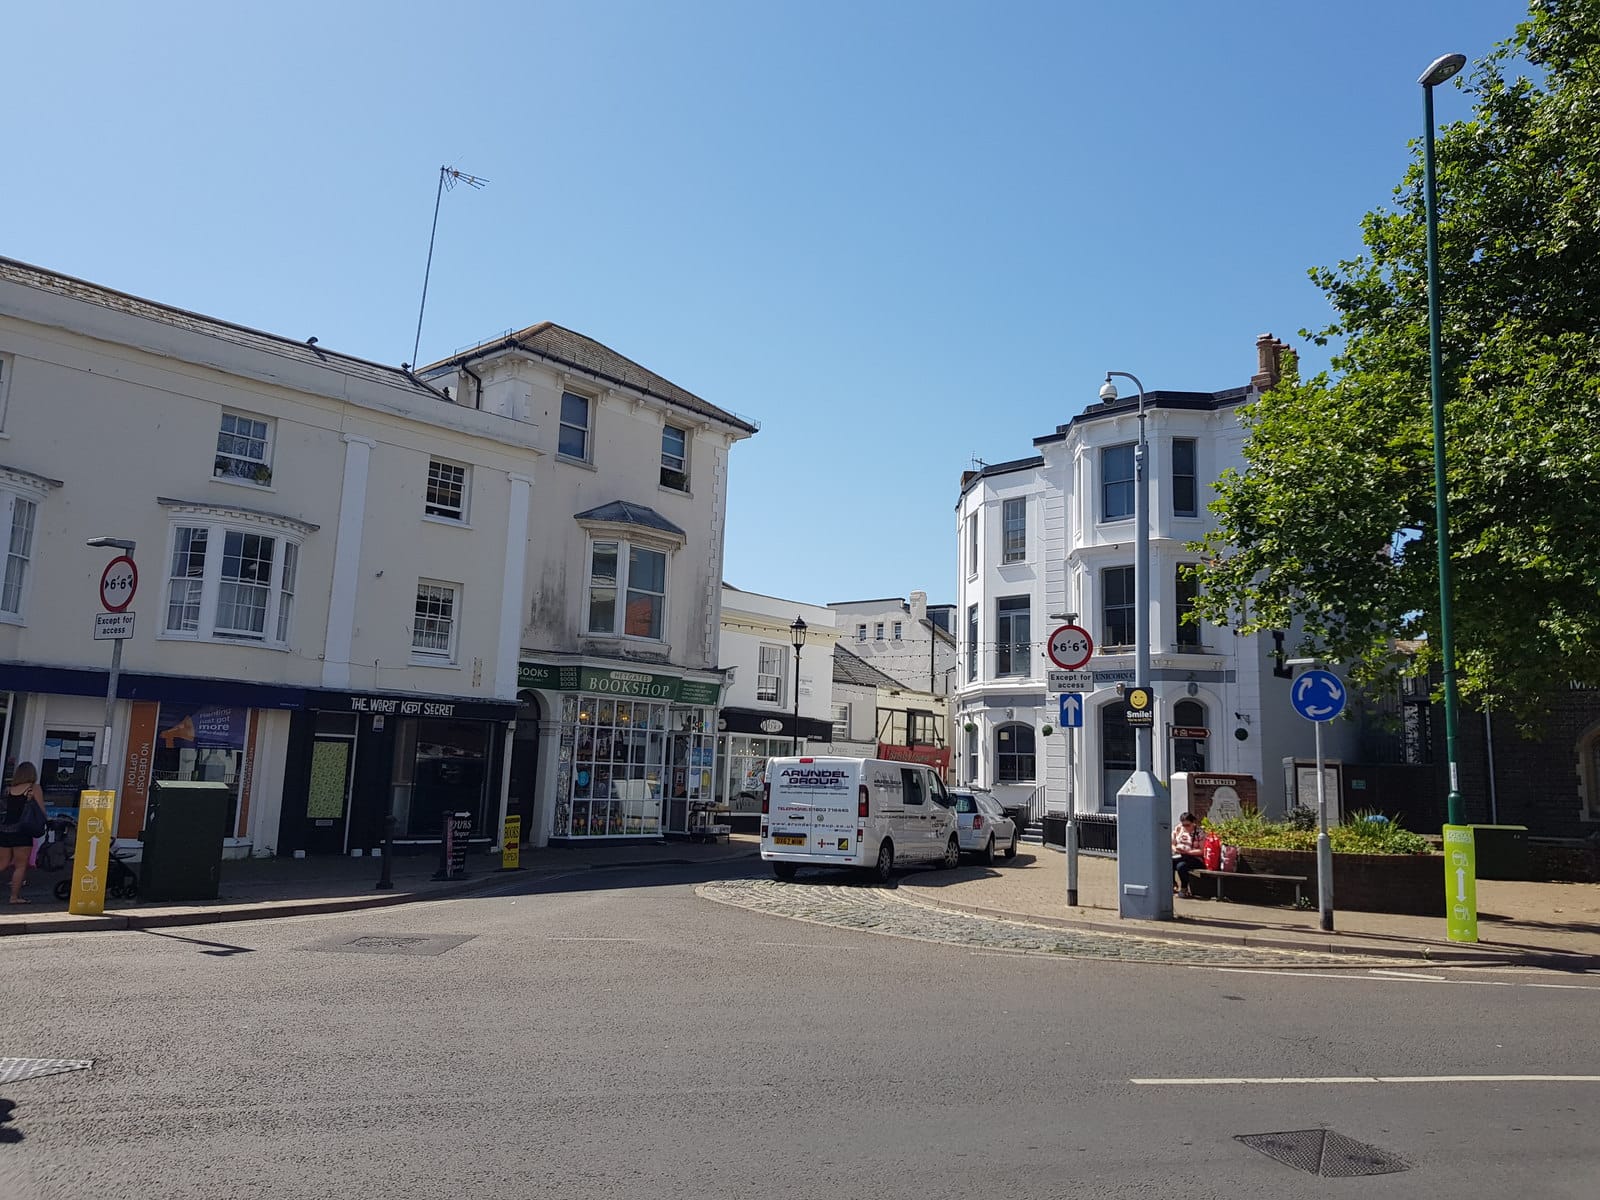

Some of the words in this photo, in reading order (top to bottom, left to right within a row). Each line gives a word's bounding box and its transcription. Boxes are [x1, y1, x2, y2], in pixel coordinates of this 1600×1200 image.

[97, 616, 121, 626] Except
[123, 615, 133, 624] for
[102, 626, 126, 635] access
[1051, 674, 1077, 682] Except
[1095, 673, 1128, 681] UNICORN
[589, 677, 670, 697] BOOKSHOP
[351, 697, 369, 711] THE
[370, 698, 400, 713] WORST
[401, 701, 424, 714] KEPT
[424, 703, 455, 716] SECRET
[1127, 710, 1152, 718] Smile!
[142, 743, 150, 756] NO
[128, 753, 139, 787] OPTION
[781, 770, 850, 778] ARUNDEL
[136, 758, 148, 795] DEPOSIT
